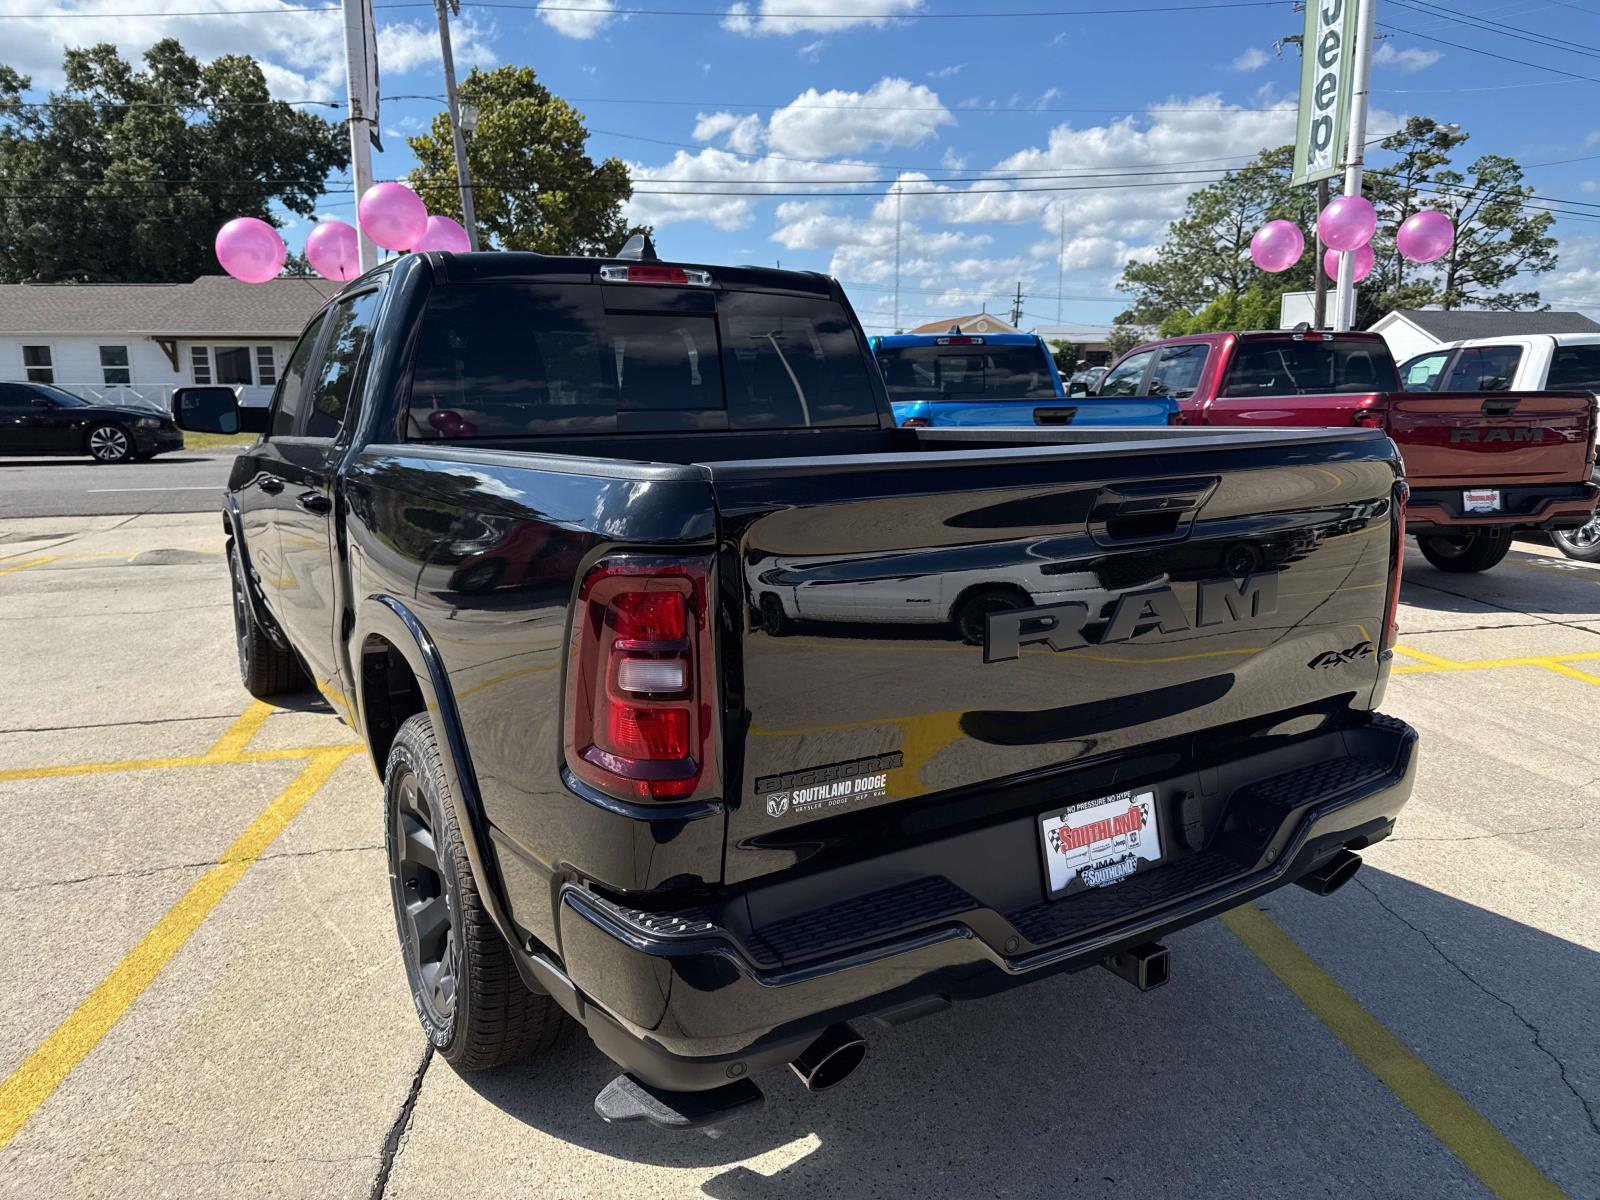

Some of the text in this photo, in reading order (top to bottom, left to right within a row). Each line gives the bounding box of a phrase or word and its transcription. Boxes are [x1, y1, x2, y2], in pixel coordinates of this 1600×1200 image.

[1450, 427, 1543, 443] RAM
[982, 570, 1280, 664] RAM
[792, 773, 888, 805] SOUTHLAND DODGE
[828, 797, 848, 807] DODGE
[1066, 790, 1131, 813] NO PRESSURE NO HYPE
[1059, 806, 1142, 854] SOUTHLAND
[1088, 859, 1133, 885] SOUTHLAND
